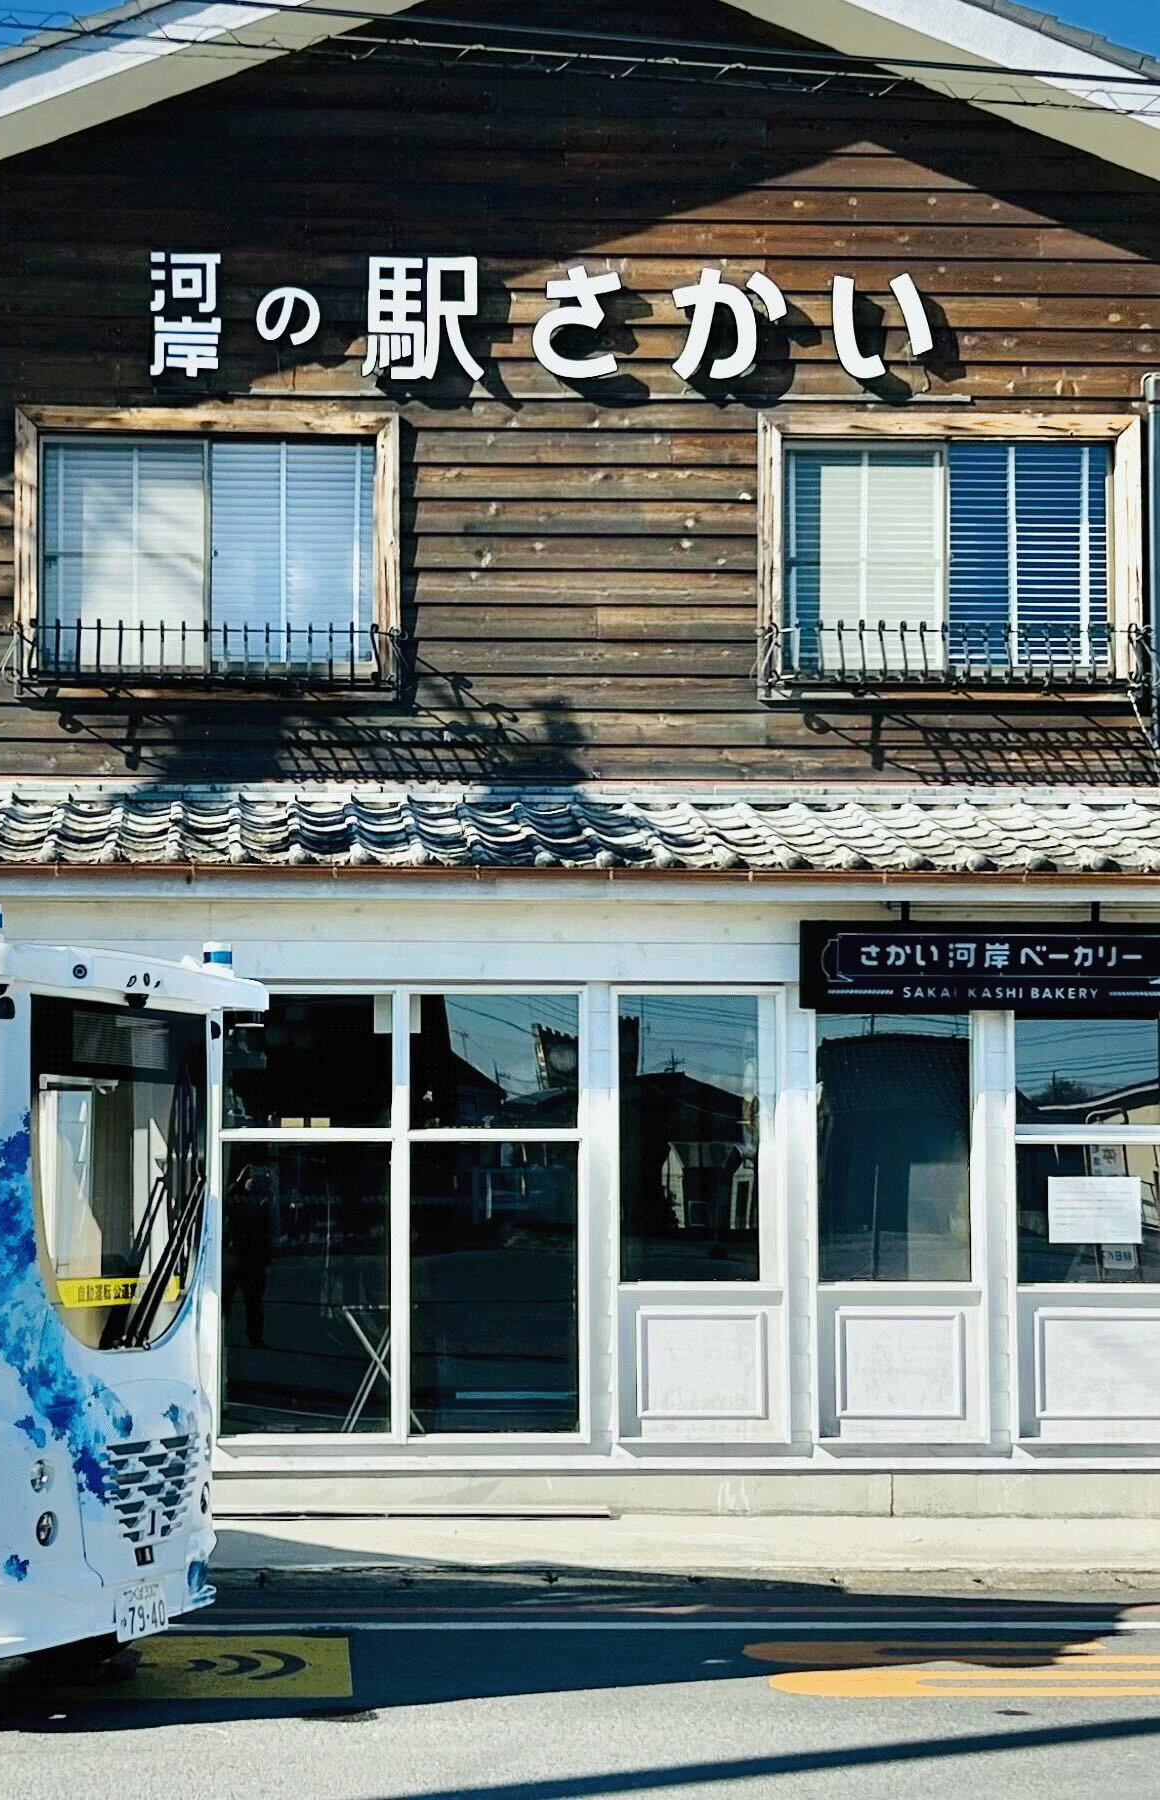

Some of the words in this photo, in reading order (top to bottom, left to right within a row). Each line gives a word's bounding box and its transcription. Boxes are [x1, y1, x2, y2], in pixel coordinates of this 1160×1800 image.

[860, 942, 1143, 969] さかい河岸ベーカリー
[902, 986, 957, 999] SAKAI
[968, 987, 1023, 999] KASHI
[1030, 987, 1099, 1000] BAKERY
